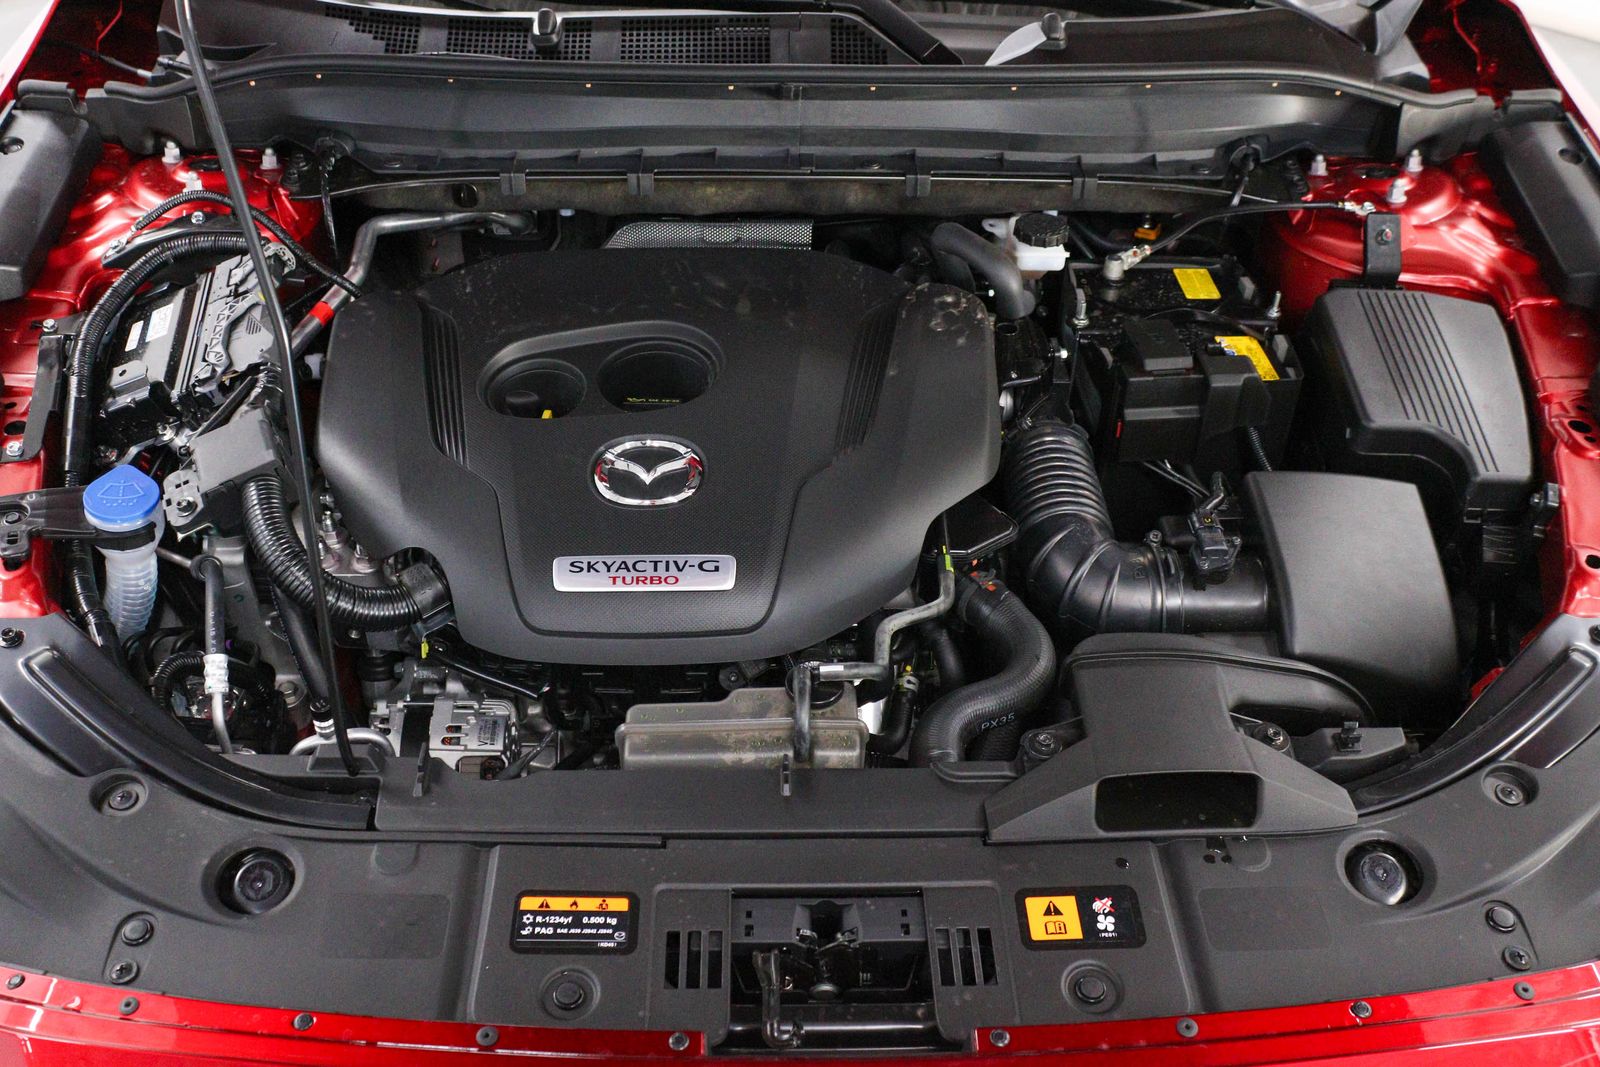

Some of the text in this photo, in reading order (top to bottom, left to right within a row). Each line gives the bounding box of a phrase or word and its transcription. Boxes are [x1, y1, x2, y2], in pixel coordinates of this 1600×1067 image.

[568, 559, 720, 574] SKYACTIV-G
[608, 575, 680, 586] TURBO
[535, 916, 618, 925] R-1234yf 0.500 kg
[534, 926, 554, 935] PAG
